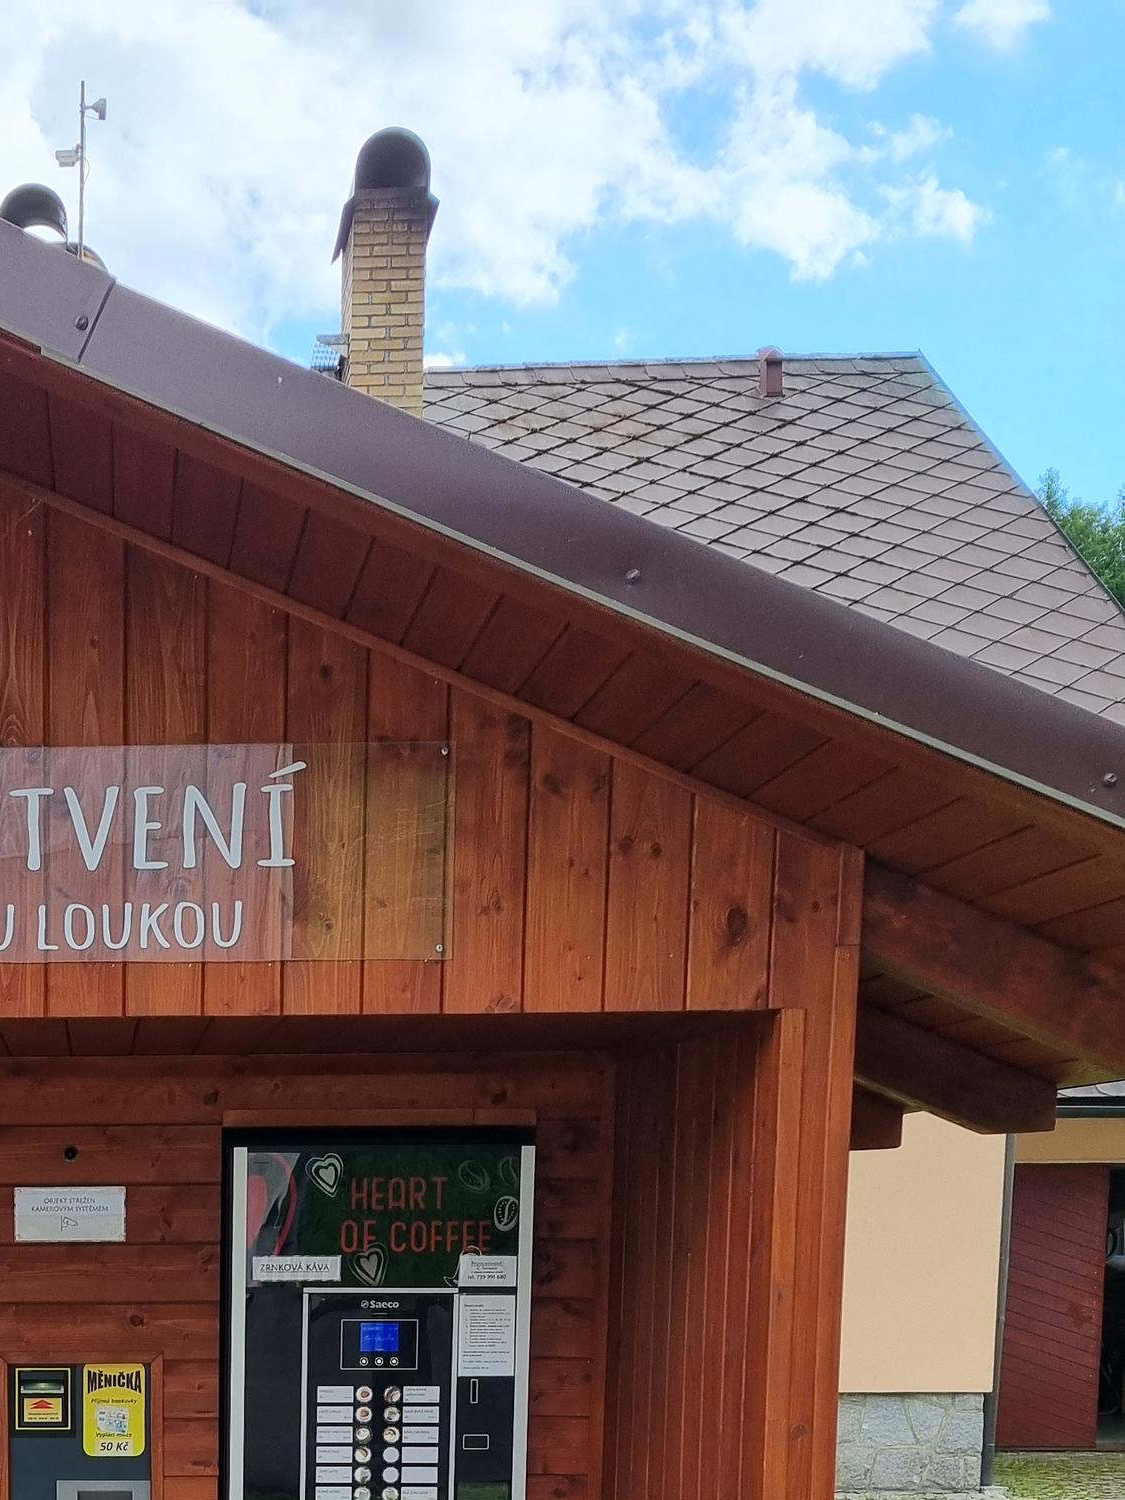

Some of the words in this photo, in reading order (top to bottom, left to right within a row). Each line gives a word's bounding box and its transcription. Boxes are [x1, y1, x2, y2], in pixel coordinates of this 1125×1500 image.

[37, 899, 244, 951] LOUKOU
[350, 1177, 449, 1210] HEART
[340, 1220, 378, 1253] OF
[390, 1220, 492, 1252] COFFEE
[260, 1261, 303, 1272] ZRNKOVÁ
[305, 1261, 330, 1272] KÁVA
[369, 1300, 400, 1309] Saeco
[87, 1369, 142, 1394] MĚNIČKA
[99, 1441, 114, 1451] 50
[116, 1441, 129, 1451] Kč
